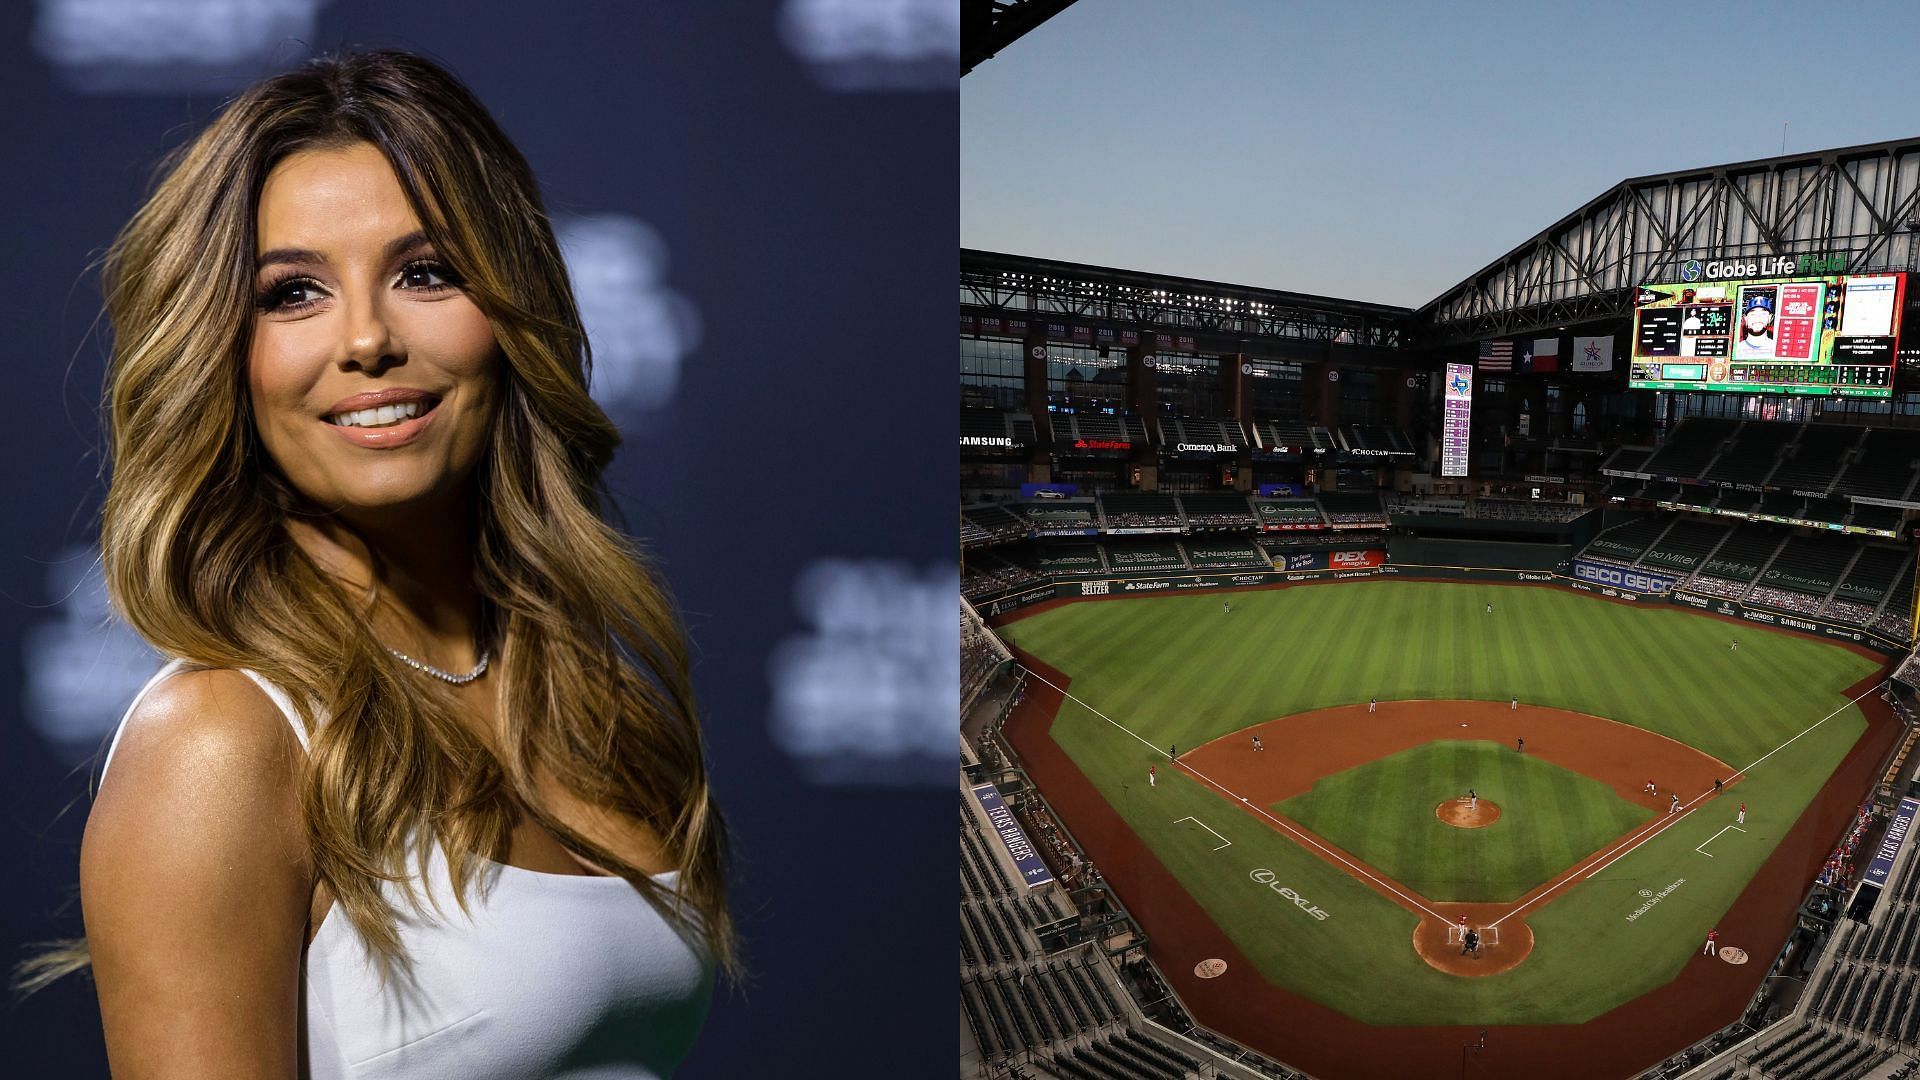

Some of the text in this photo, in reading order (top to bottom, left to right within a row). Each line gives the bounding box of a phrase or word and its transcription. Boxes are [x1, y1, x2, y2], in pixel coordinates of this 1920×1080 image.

[1705, 253, 1847, 279] Globe Life Field
[1217, 444, 1238, 452] Bank
[1334, 550, 1368, 562] DEX
[1664, 553, 1698, 565] Mitel
[1575, 564, 1622, 584] GEICO
[1782, 574, 1831, 587] CenturyLink
[1081, 585, 1109, 595] SELTZER
[1135, 582, 1170, 590] StateFarm
[1851, 585, 1882, 597] Ashley
[1682, 594, 1709, 605] National
[1780, 618, 1816, 631] SAMSUNG
[988, 805, 1034, 861] TEXAS RANGERS
[1877, 814, 1911, 862] TEXAS RANGERS
[1269, 881, 1331, 921] LEXUS
[1625, 878, 1686, 922] Medical City Healthcare
